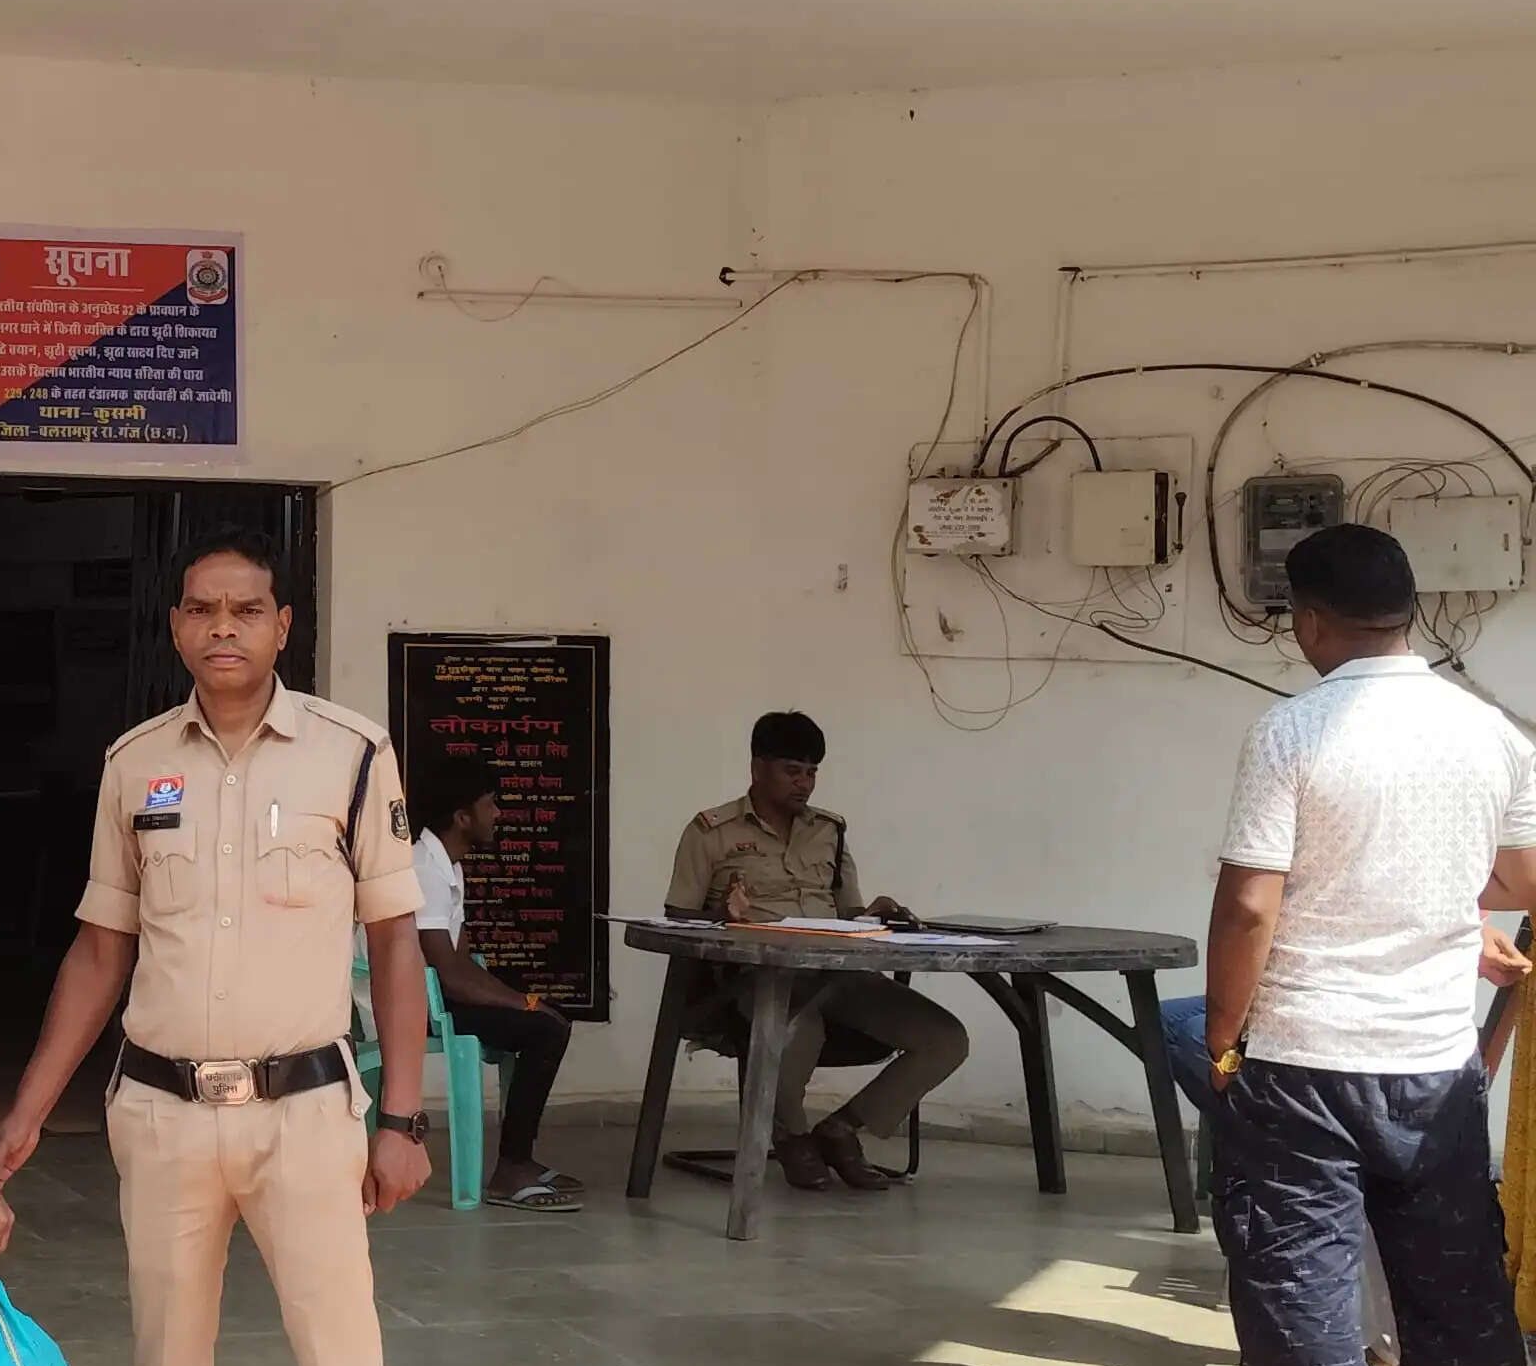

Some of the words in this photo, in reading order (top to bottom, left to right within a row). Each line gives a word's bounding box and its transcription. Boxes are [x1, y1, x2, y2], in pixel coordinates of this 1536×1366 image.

[44, 246, 132, 287] सूचना
[69, 300, 81, 314] के
[122, 304, 134, 316] 32
[189, 303, 201, 317] के
[20, 320, 41, 334] थाने
[43, 320, 53, 334] में
[54, 321, 82, 335] किसी
[116, 323, 127, 336] के
[152, 324, 173, 341] झूठी
[175, 324, 218, 339] शिकायत
[44, 343, 65, 360] झूठी
[156, 344, 176, 359] दिए
[177, 345, 199, 360] जाने
[0, 363, 27, 377] उसके
[68, 364, 105, 378] भारतीय
[107, 367, 132, 379] न्याय
[134, 366, 165, 380] संहिता
[167, 367, 182, 380] की
[50, 385, 62, 400] के
[64, 388, 86, 400] तहत
[179, 388, 194, 402] की
[429, 715, 564, 735] लोकार्पण
